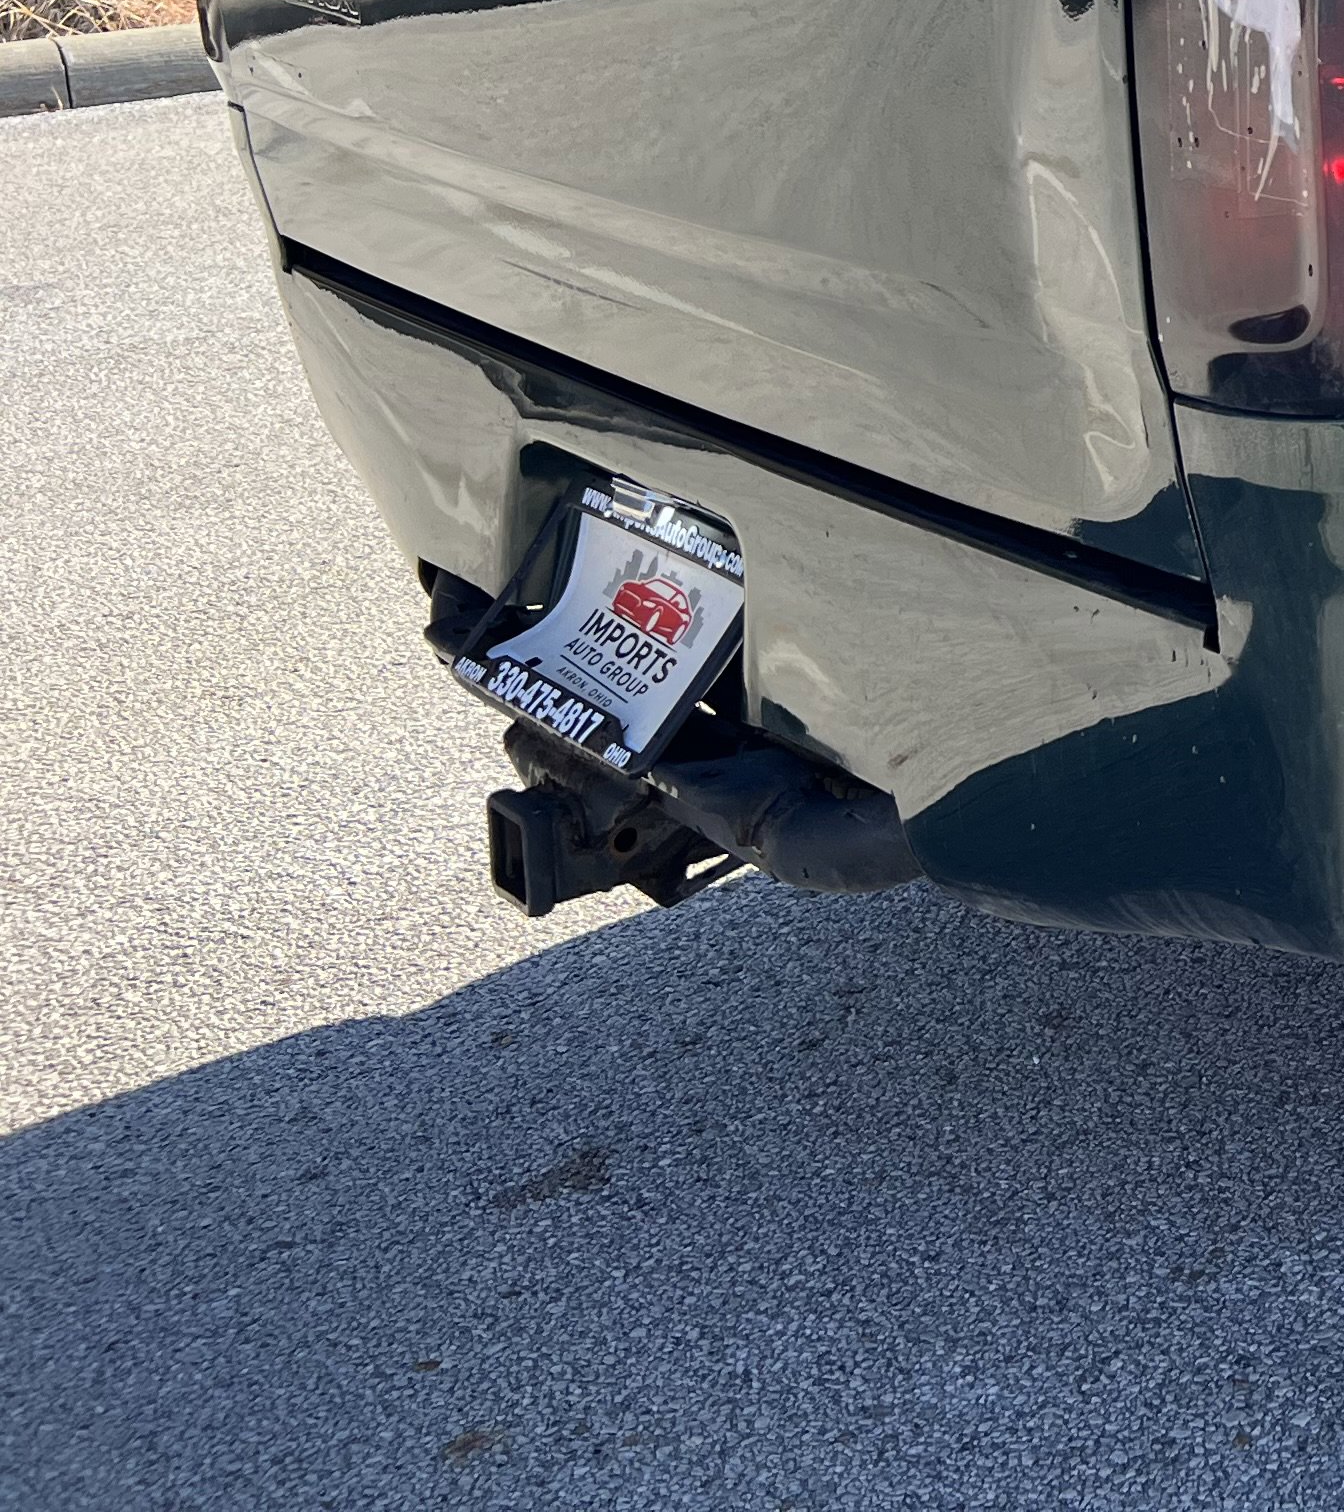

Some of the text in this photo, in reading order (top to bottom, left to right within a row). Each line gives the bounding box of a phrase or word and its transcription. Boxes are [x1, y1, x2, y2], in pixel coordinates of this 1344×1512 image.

[454, 656, 488, 683] AKRON
[563, 637, 649, 697] AUTO GROUP
[578, 608, 678, 684] IMPORTS
[487, 661, 605, 744] 330-475-4817
[556, 666, 614, 708] AKRON, OHIO
[602, 742, 632, 768] OHIO
